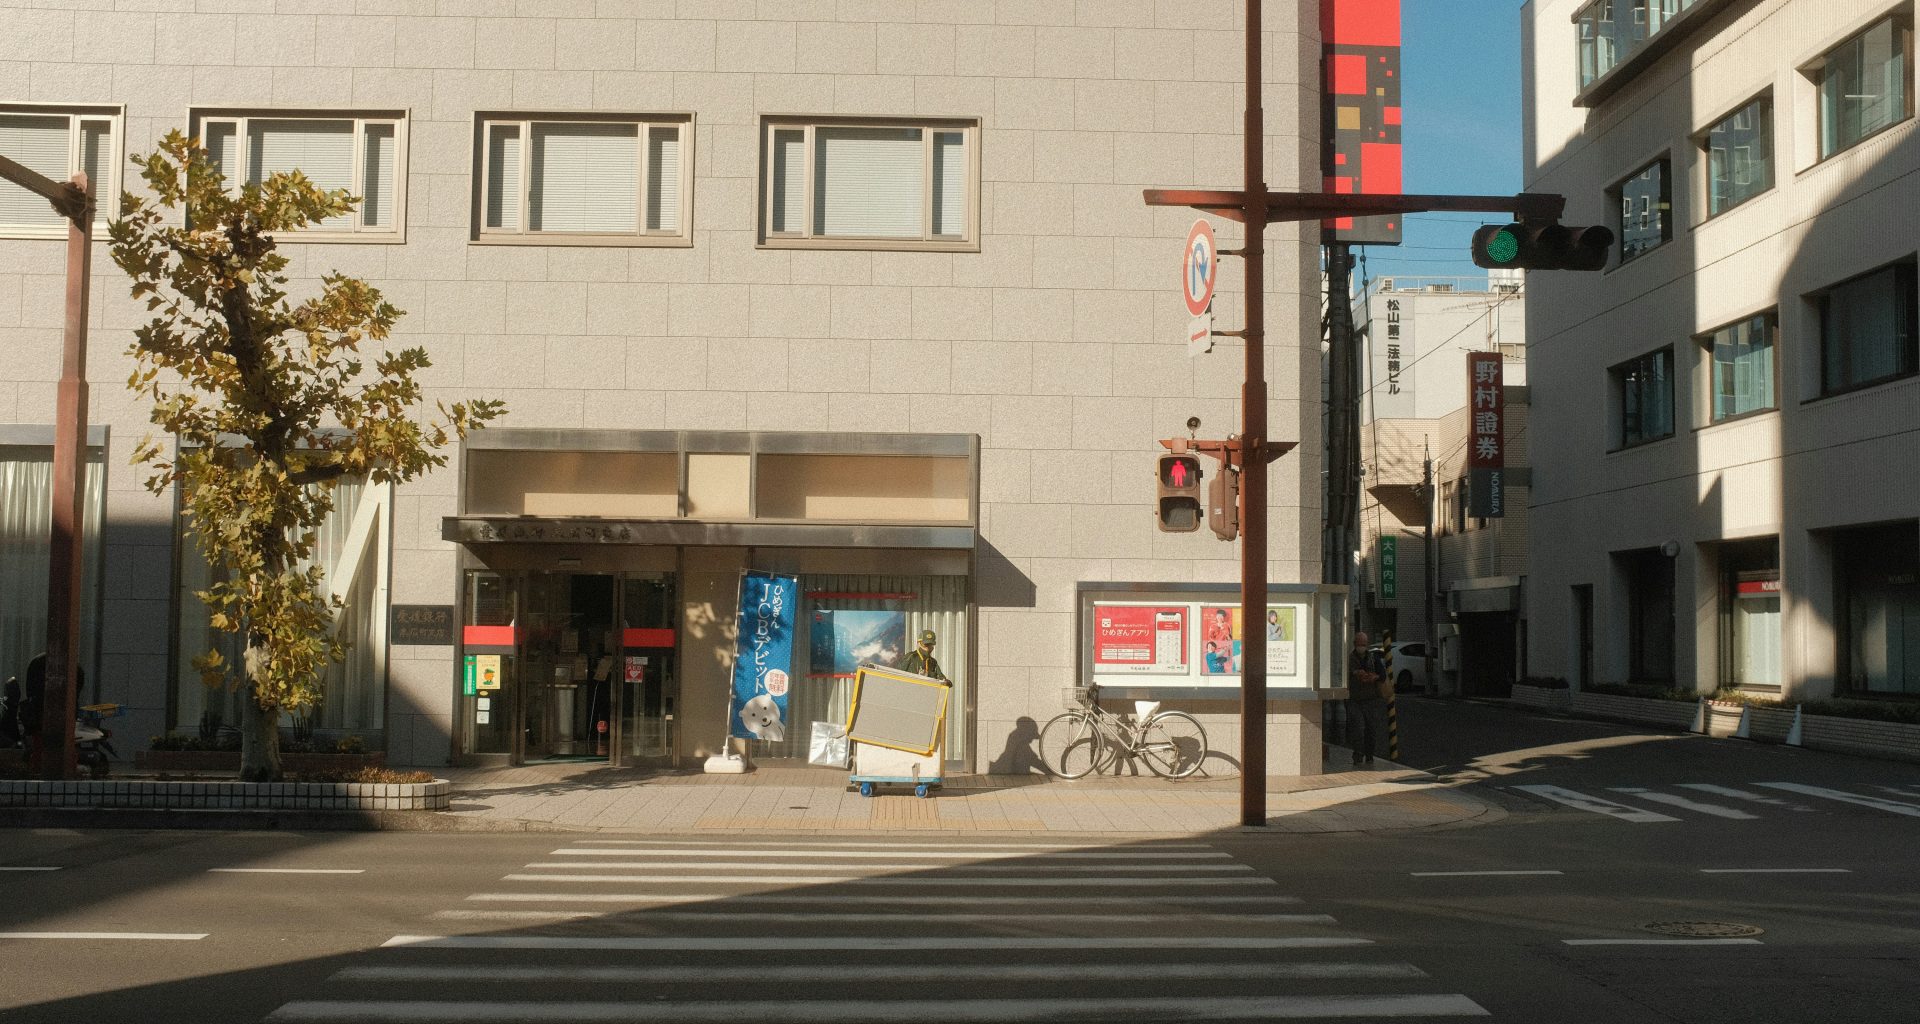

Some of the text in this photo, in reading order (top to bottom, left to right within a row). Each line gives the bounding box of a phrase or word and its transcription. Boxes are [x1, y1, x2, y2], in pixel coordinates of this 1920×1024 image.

[1387, 299, 1400, 395] 松山第二法務ビル
[1475, 360, 1499, 460] 野村證券
[1491, 472, 1499, 514] NOMURA
[1383, 540, 1394, 594] 大西内科
[770, 585, 784, 629] ひめぎん
[1102, 629, 1150, 637] ひめぎんアプリ
[754, 583, 771, 694] JCBデビット
